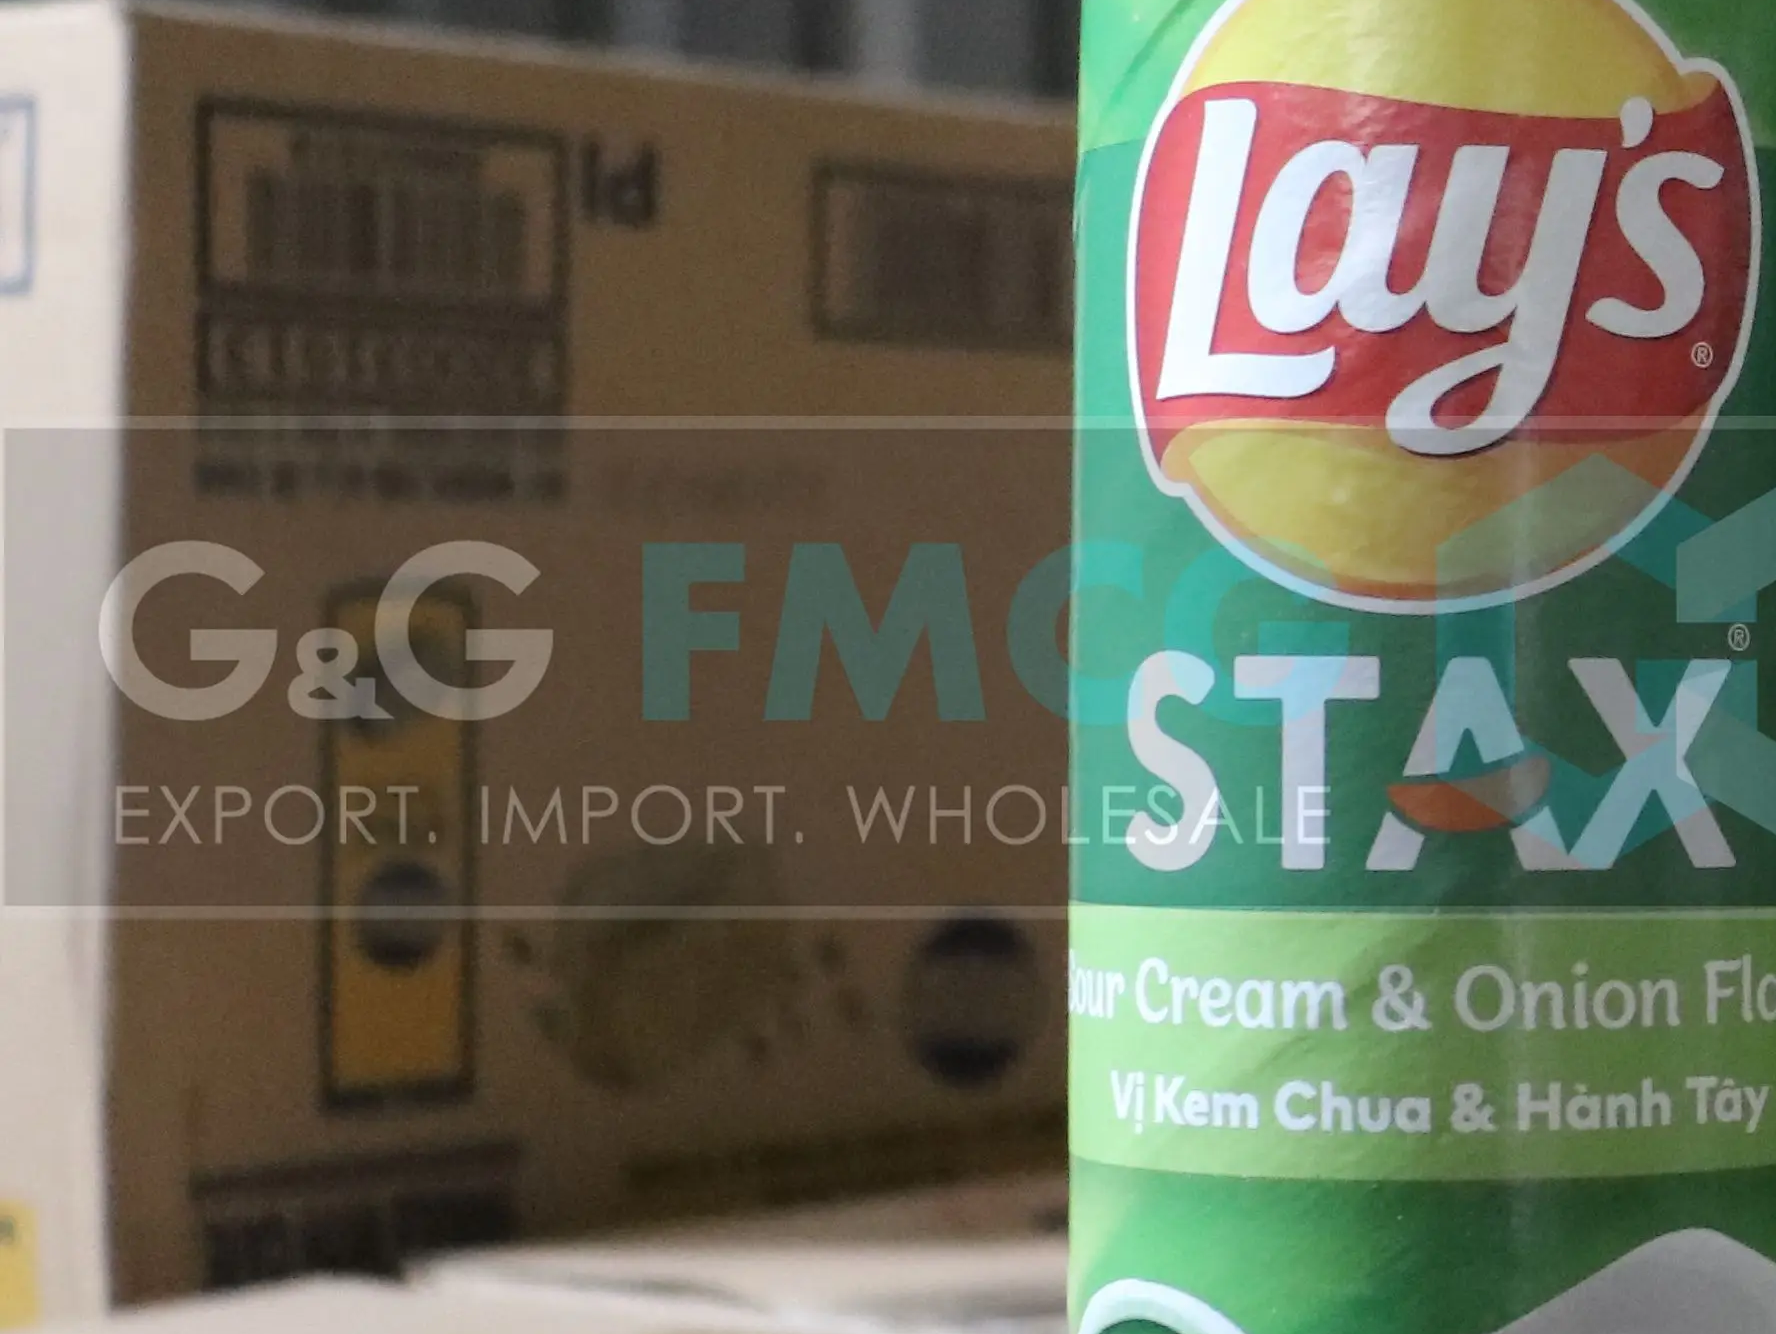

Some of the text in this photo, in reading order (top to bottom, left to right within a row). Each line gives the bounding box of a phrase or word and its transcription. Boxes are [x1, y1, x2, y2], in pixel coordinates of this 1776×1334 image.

[1155, 96, 1725, 458] Lay's
[1126, 651, 1737, 872] STAX
[1136, 957, 1348, 1030] Cream
[1371, 964, 1432, 1032] &
[1454, 961, 1681, 1032] Onion
[1110, 1071, 1769, 1134] Vị Kem Chua & Hành Tây
